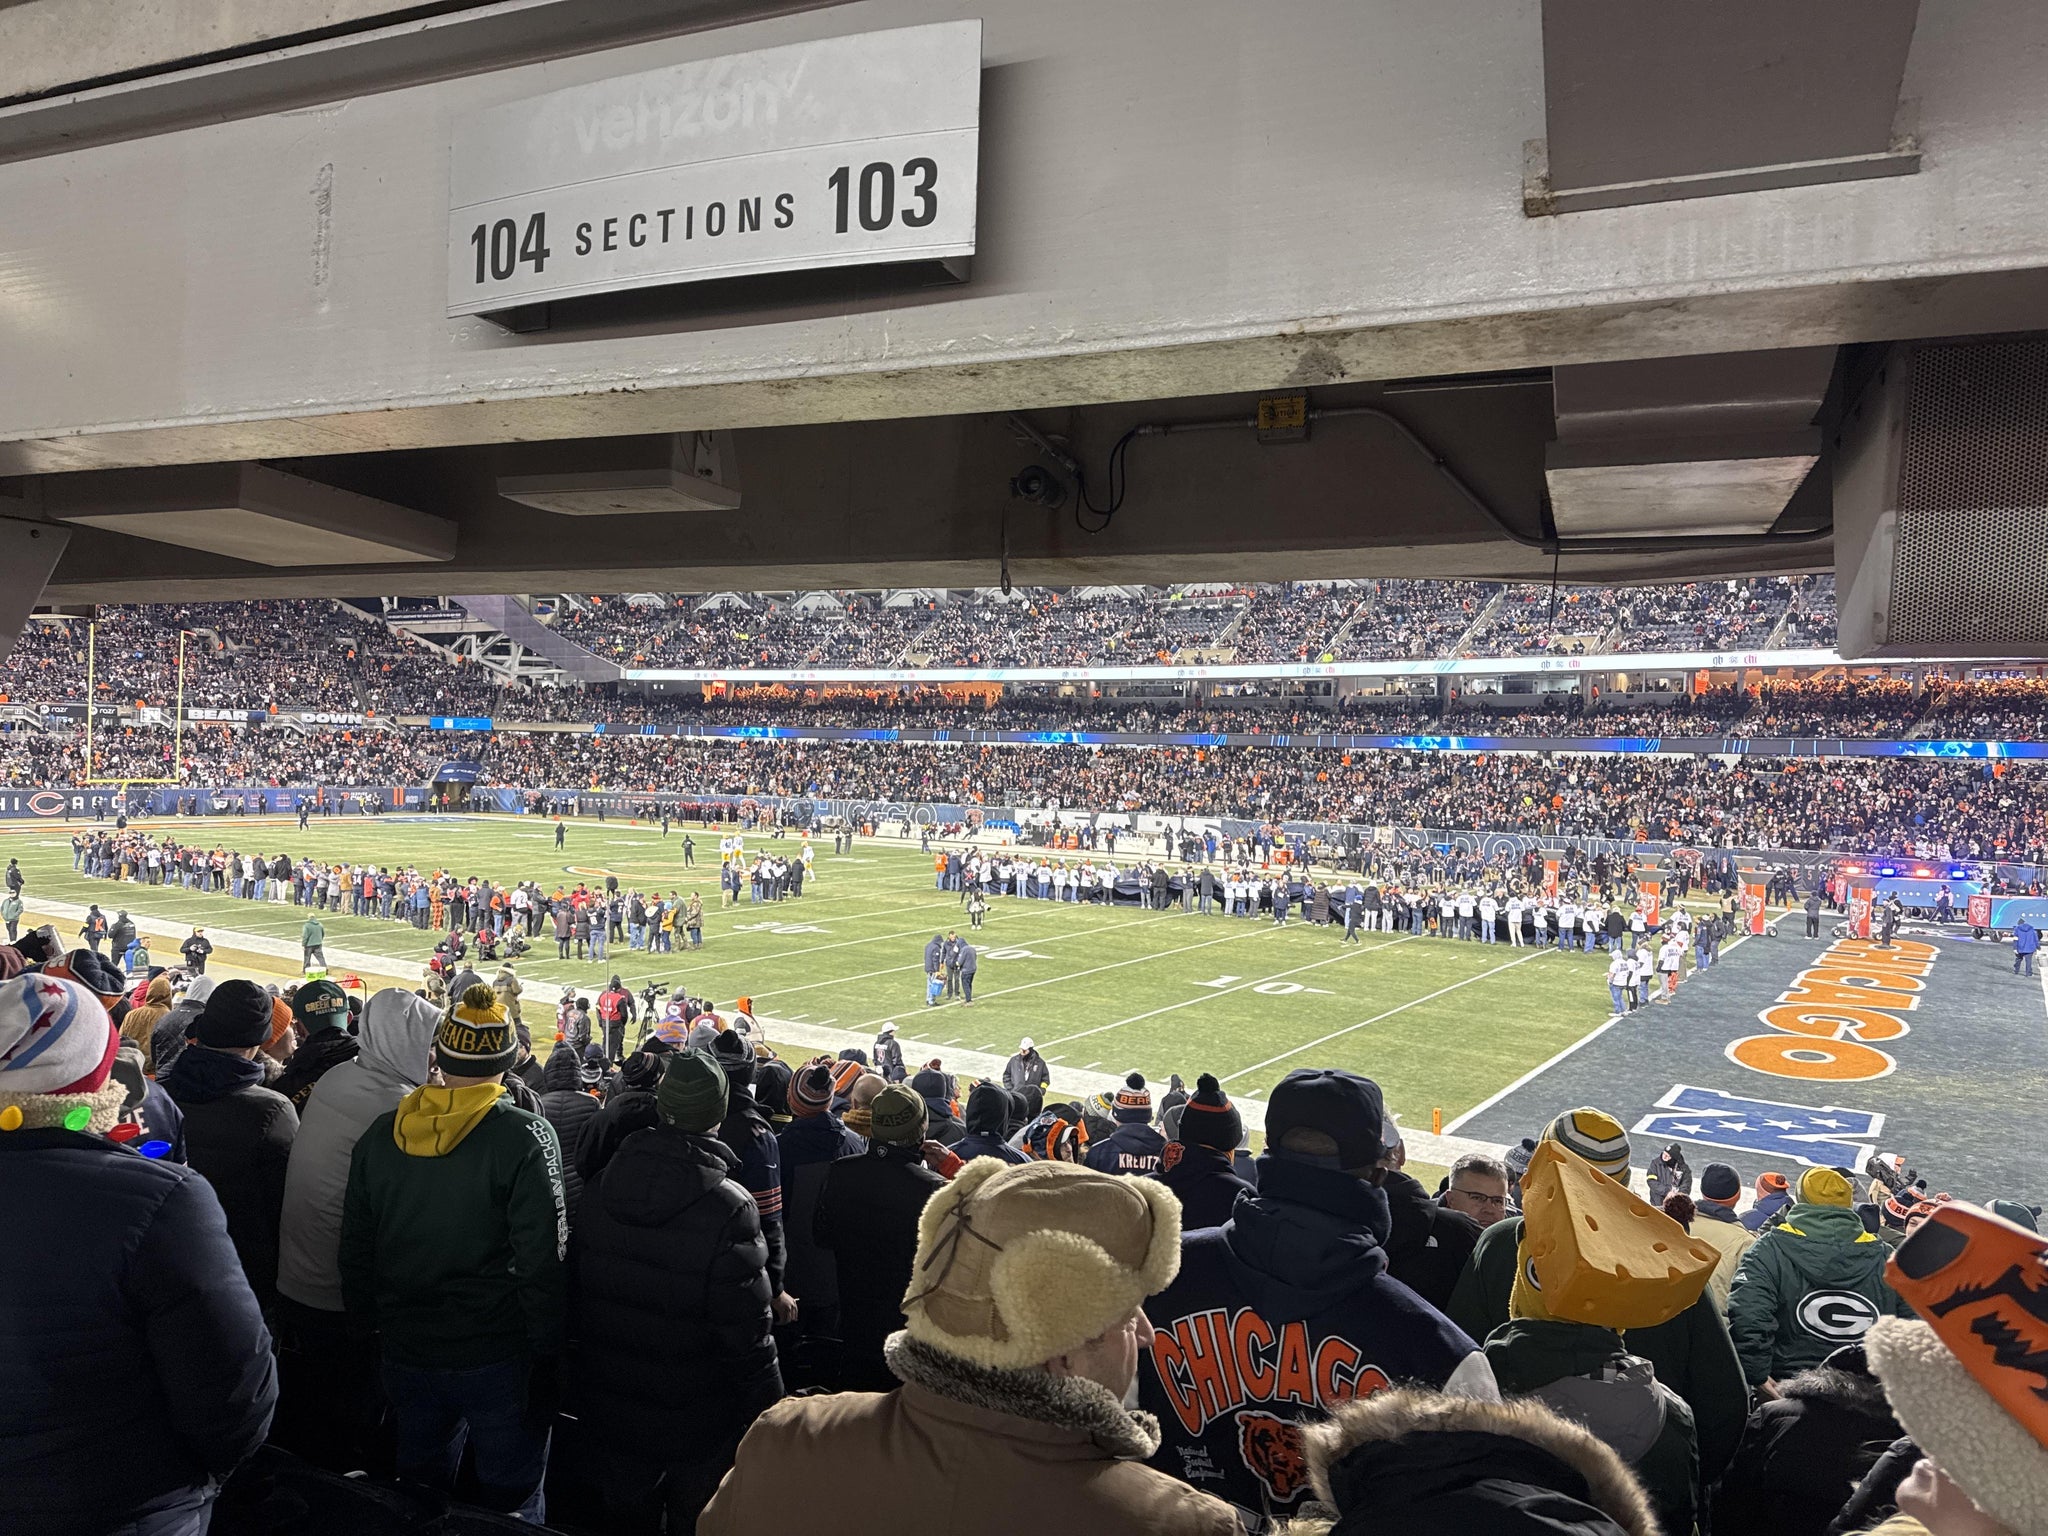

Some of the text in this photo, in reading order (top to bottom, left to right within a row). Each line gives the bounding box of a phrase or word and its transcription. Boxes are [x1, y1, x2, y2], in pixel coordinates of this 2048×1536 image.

[573, 74, 780, 153] verizon
[470, 157, 938, 284] 104 SECTIONS 103
[188, 709, 248, 720] BEAR
[301, 713, 362, 724] DOWN
[305, 997, 344, 1013] GREEN BAY
[461, 1028, 504, 1052] BAY
[525, 1120, 561, 1177] PACKERS
[550, 1178, 566, 1209] BAY
